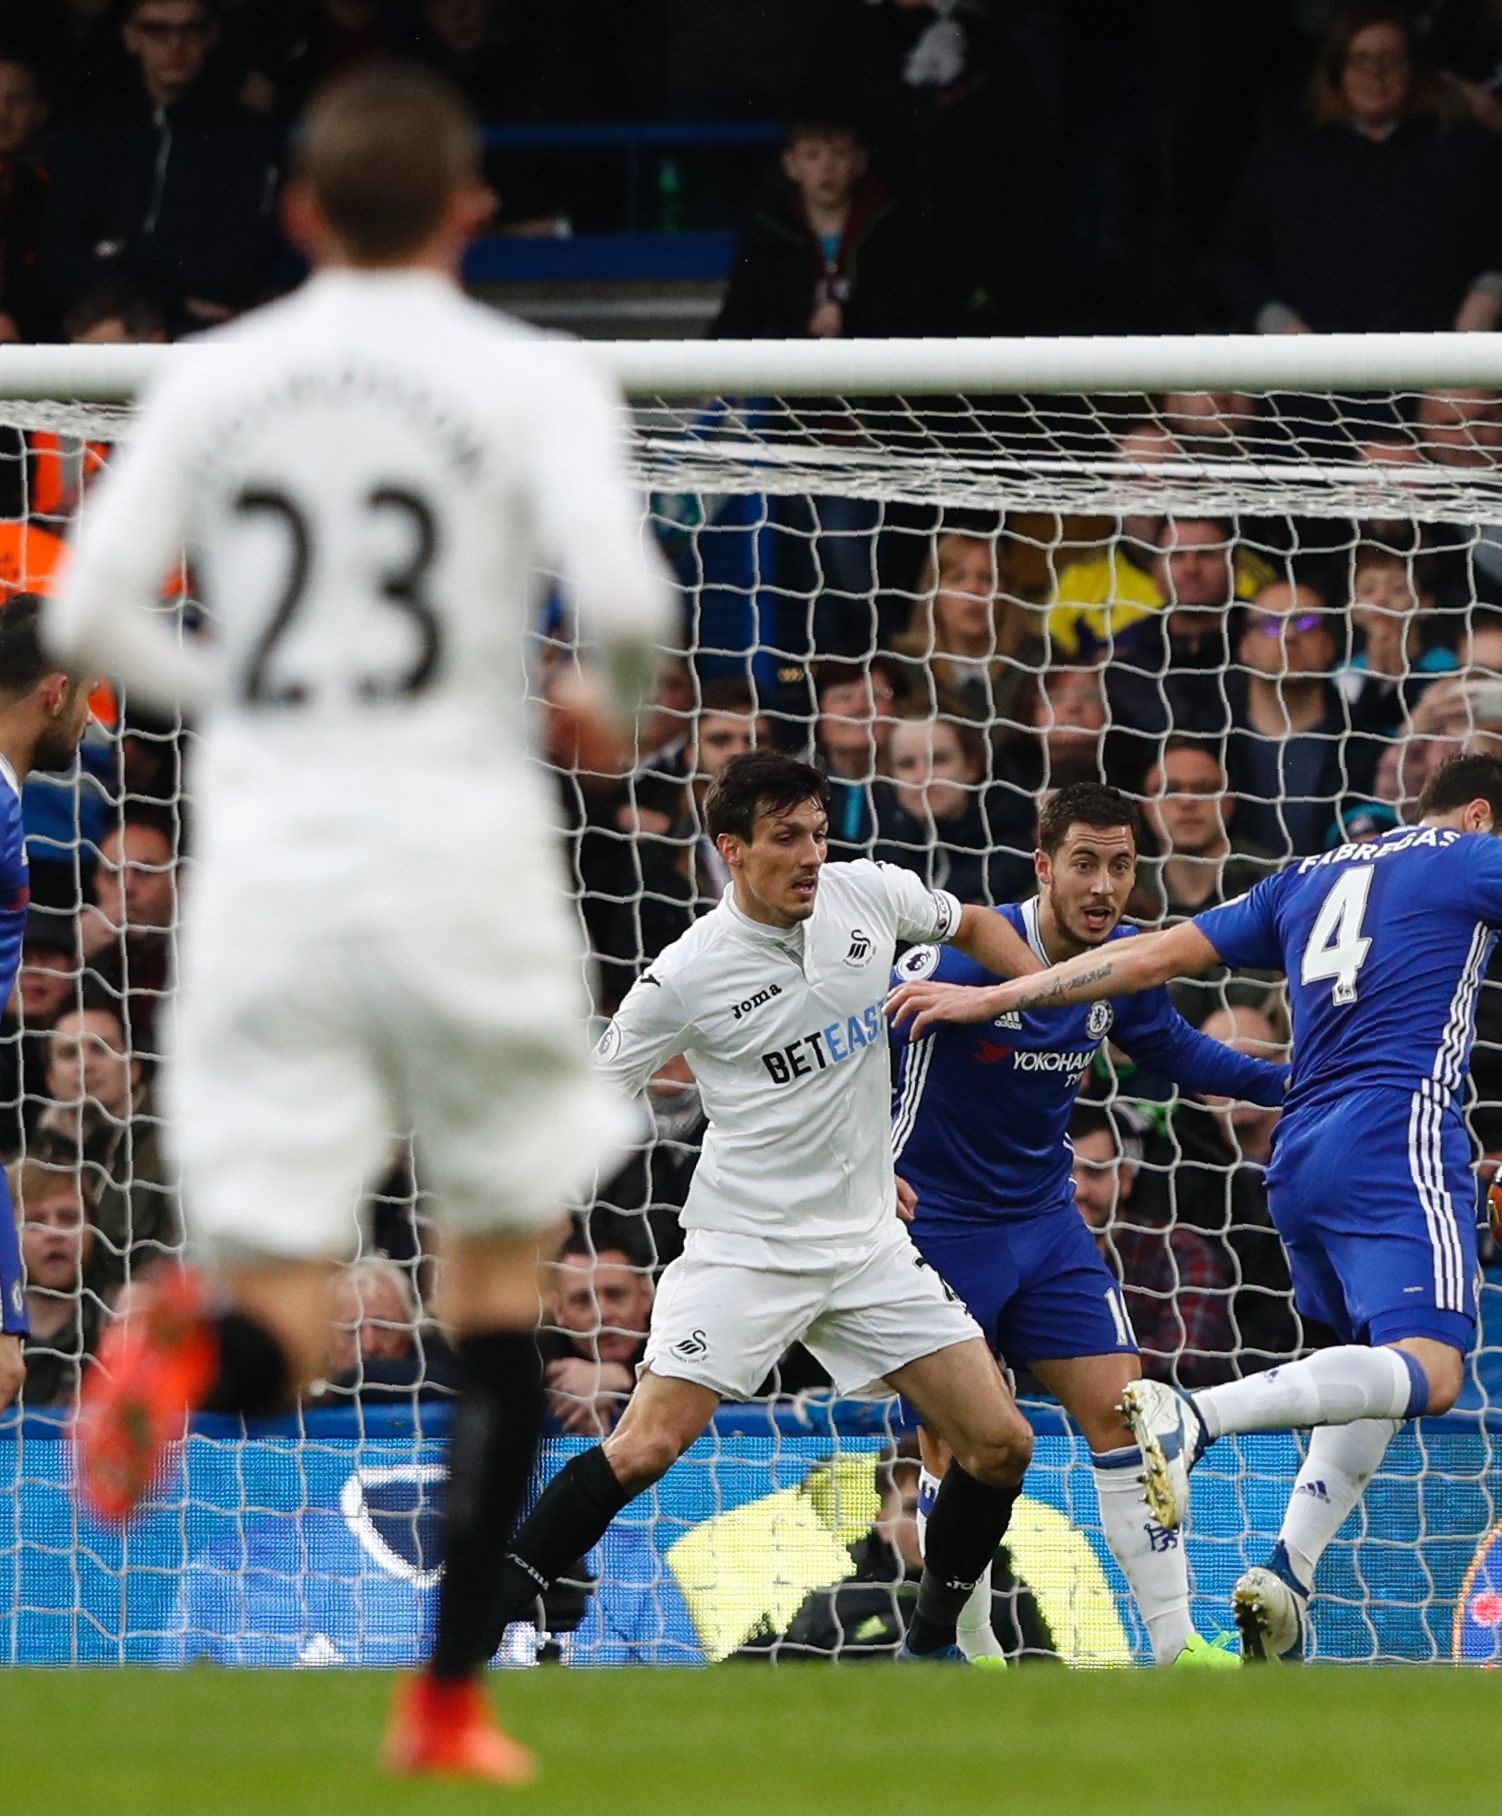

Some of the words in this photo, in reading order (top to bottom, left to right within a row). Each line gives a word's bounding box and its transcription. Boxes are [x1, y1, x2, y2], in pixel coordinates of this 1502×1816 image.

[232, 480, 444, 706] 23
[1298, 826, 1462, 874] FABREGAS
[1301, 863, 1375, 1006] 4
[1013, 1049, 1096, 1072] YOKOHAM
